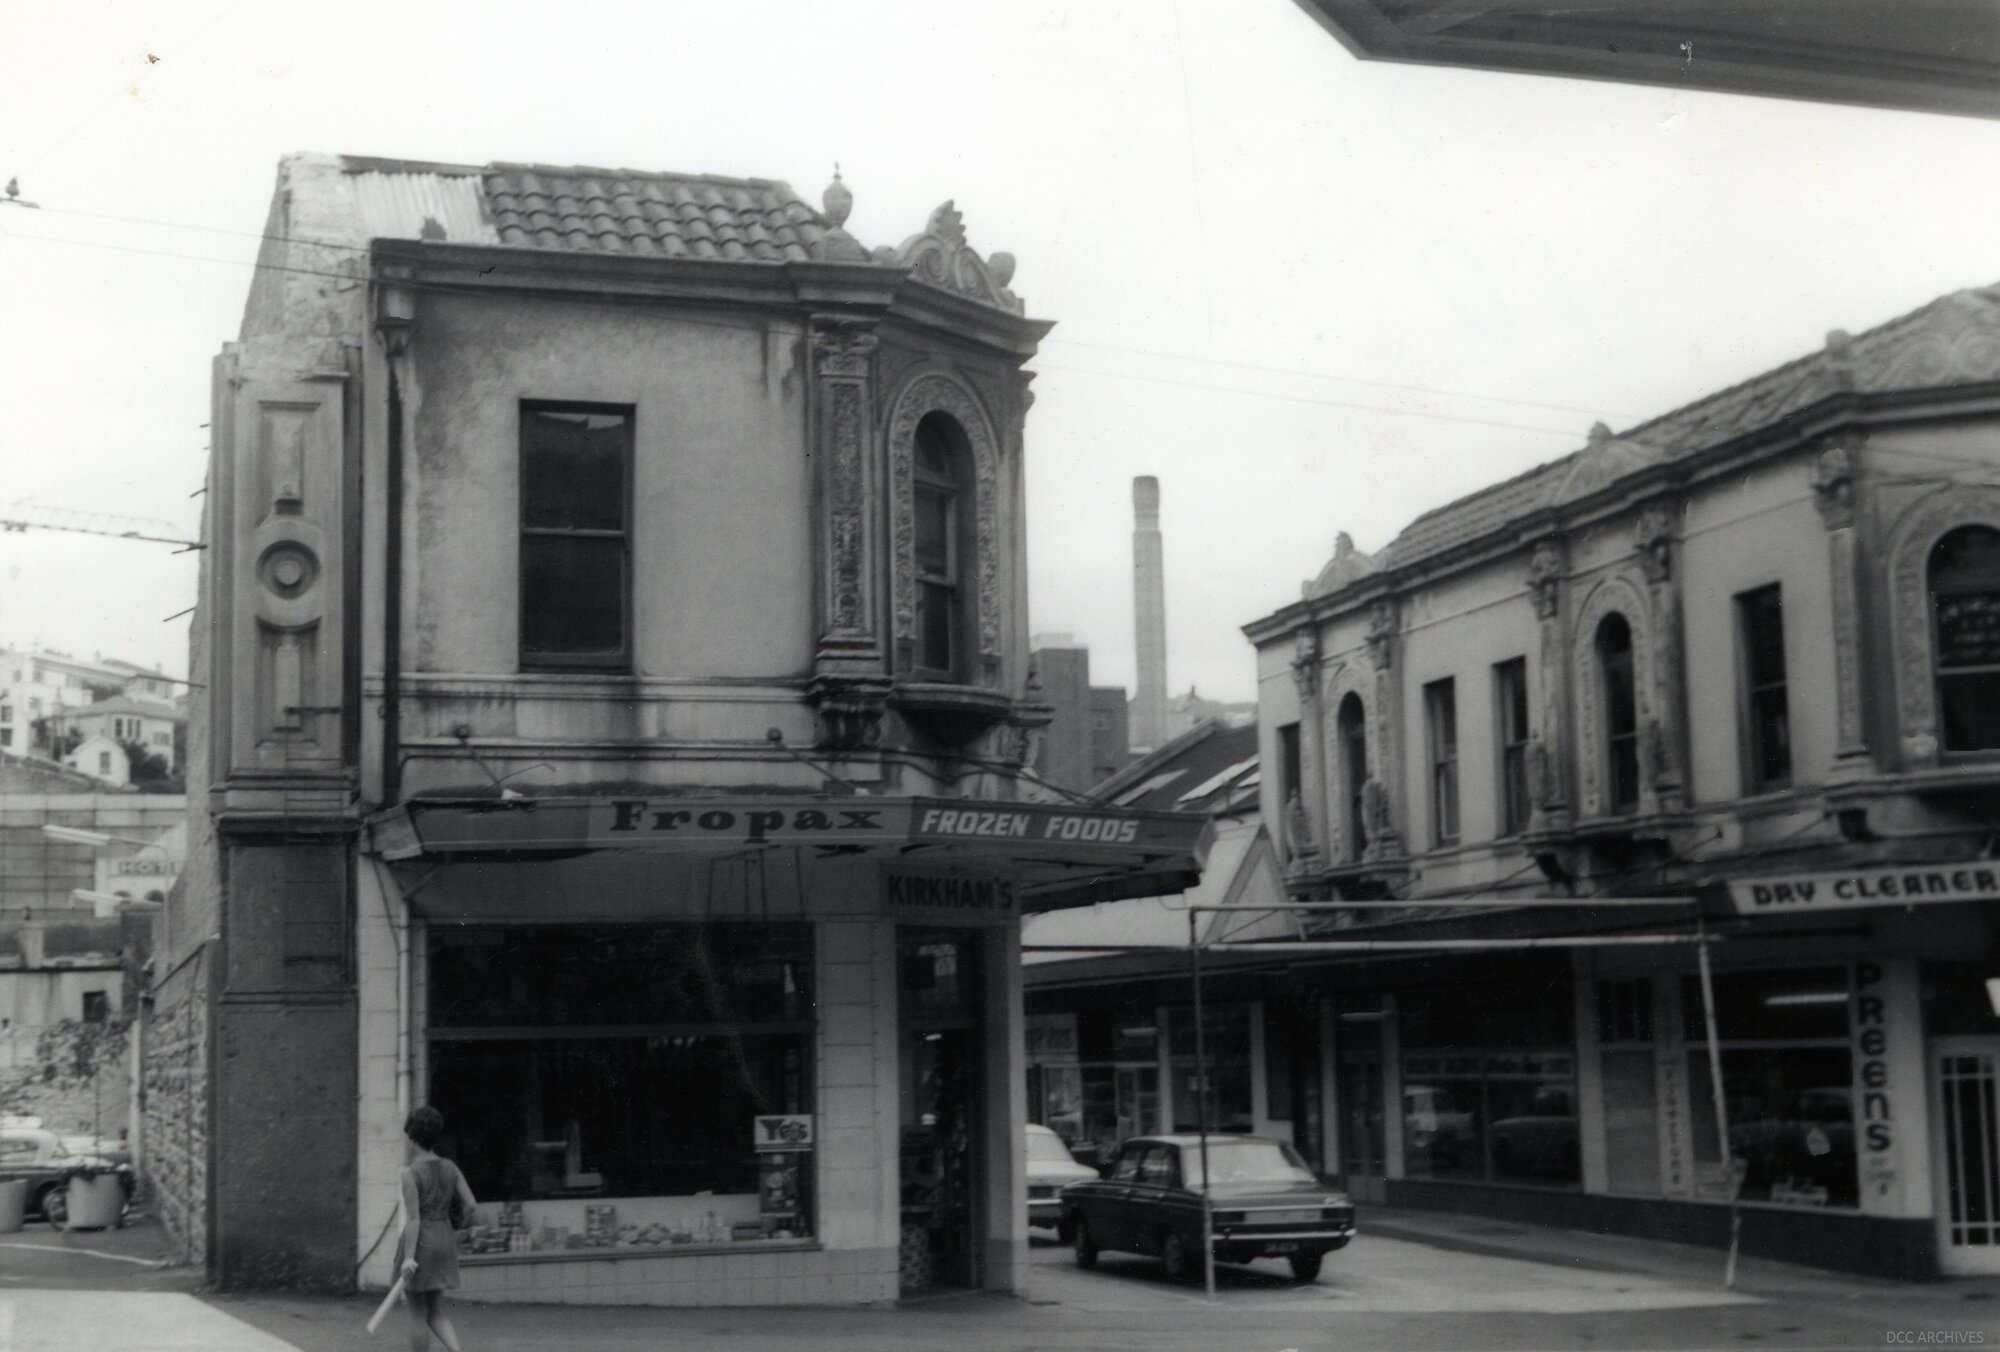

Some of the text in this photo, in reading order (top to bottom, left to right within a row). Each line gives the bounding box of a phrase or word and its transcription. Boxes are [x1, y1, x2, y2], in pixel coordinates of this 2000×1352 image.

[610, 800, 883, 843] Fropax
[921, 809, 1140, 842] FROZEN FOODS
[888, 875, 1013, 909] KIRKHAM'S
[1752, 882, 1815, 905] DRY
